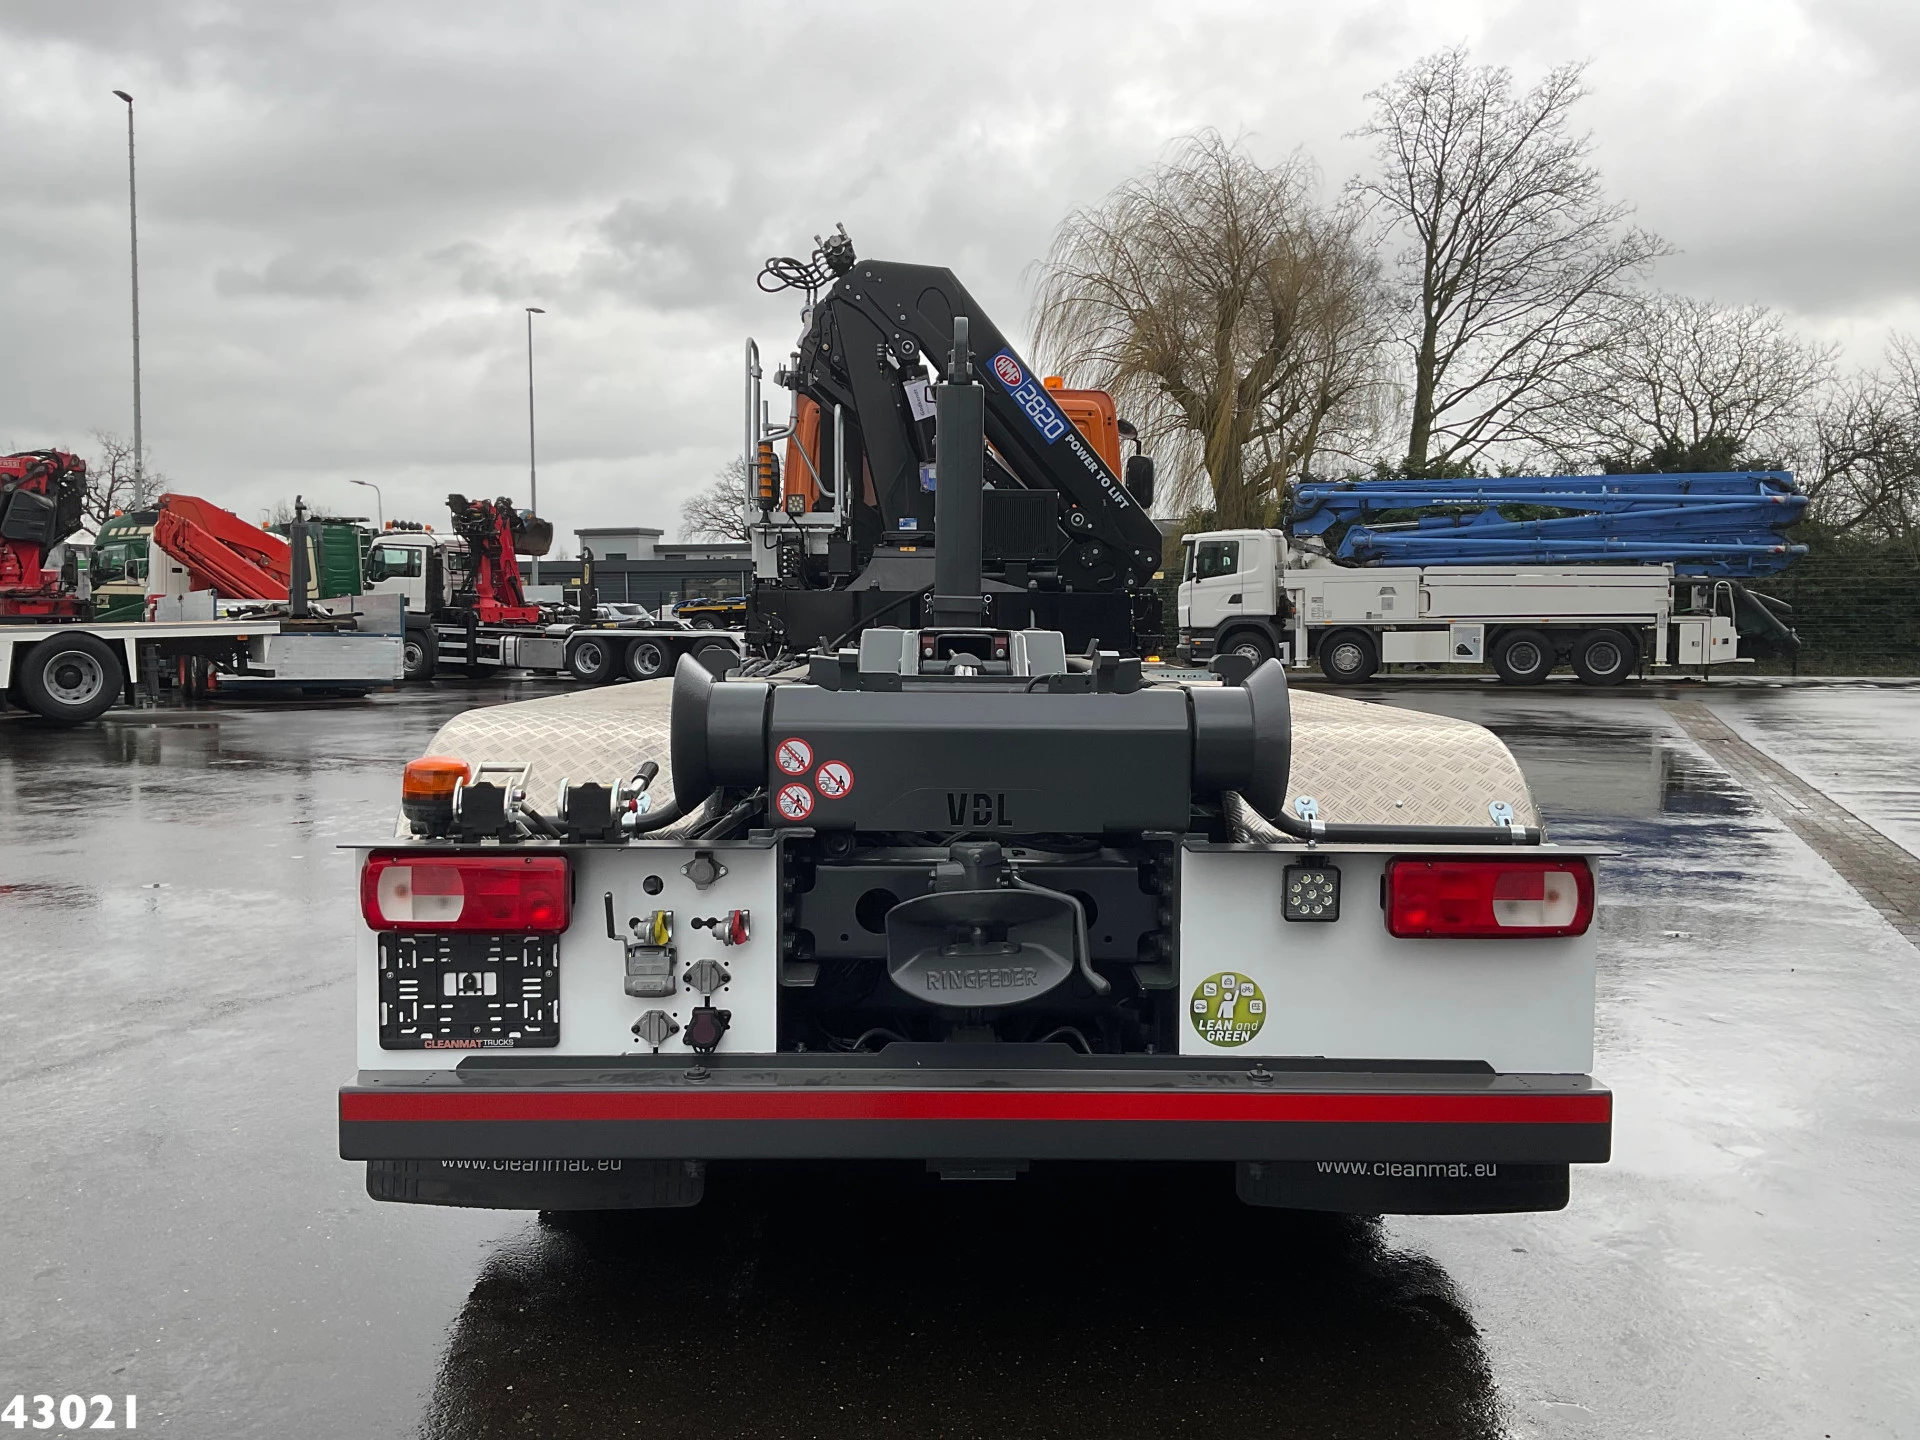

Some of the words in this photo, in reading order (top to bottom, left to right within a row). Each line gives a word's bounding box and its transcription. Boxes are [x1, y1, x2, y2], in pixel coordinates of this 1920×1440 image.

[997, 358, 1020, 382] HMF
[1015, 384, 1065, 439] 2820
[1065, 433, 1099, 473] POWER
[1096, 470, 1111, 488] TO
[1107, 486, 1130, 509] LIFT
[946, 793, 1013, 827] VDL
[926, 966, 1039, 991] RINGFEDER
[1198, 1019, 1234, 1031] LEAN
[1236, 1020, 1259, 1031] and
[424, 1039, 483, 1049] CLEANMAT
[483, 1038, 514, 1047] TRUCKS
[1206, 1030, 1251, 1042] GREEN
[1316, 1161, 1497, 1178] www.cleanmat.eu
